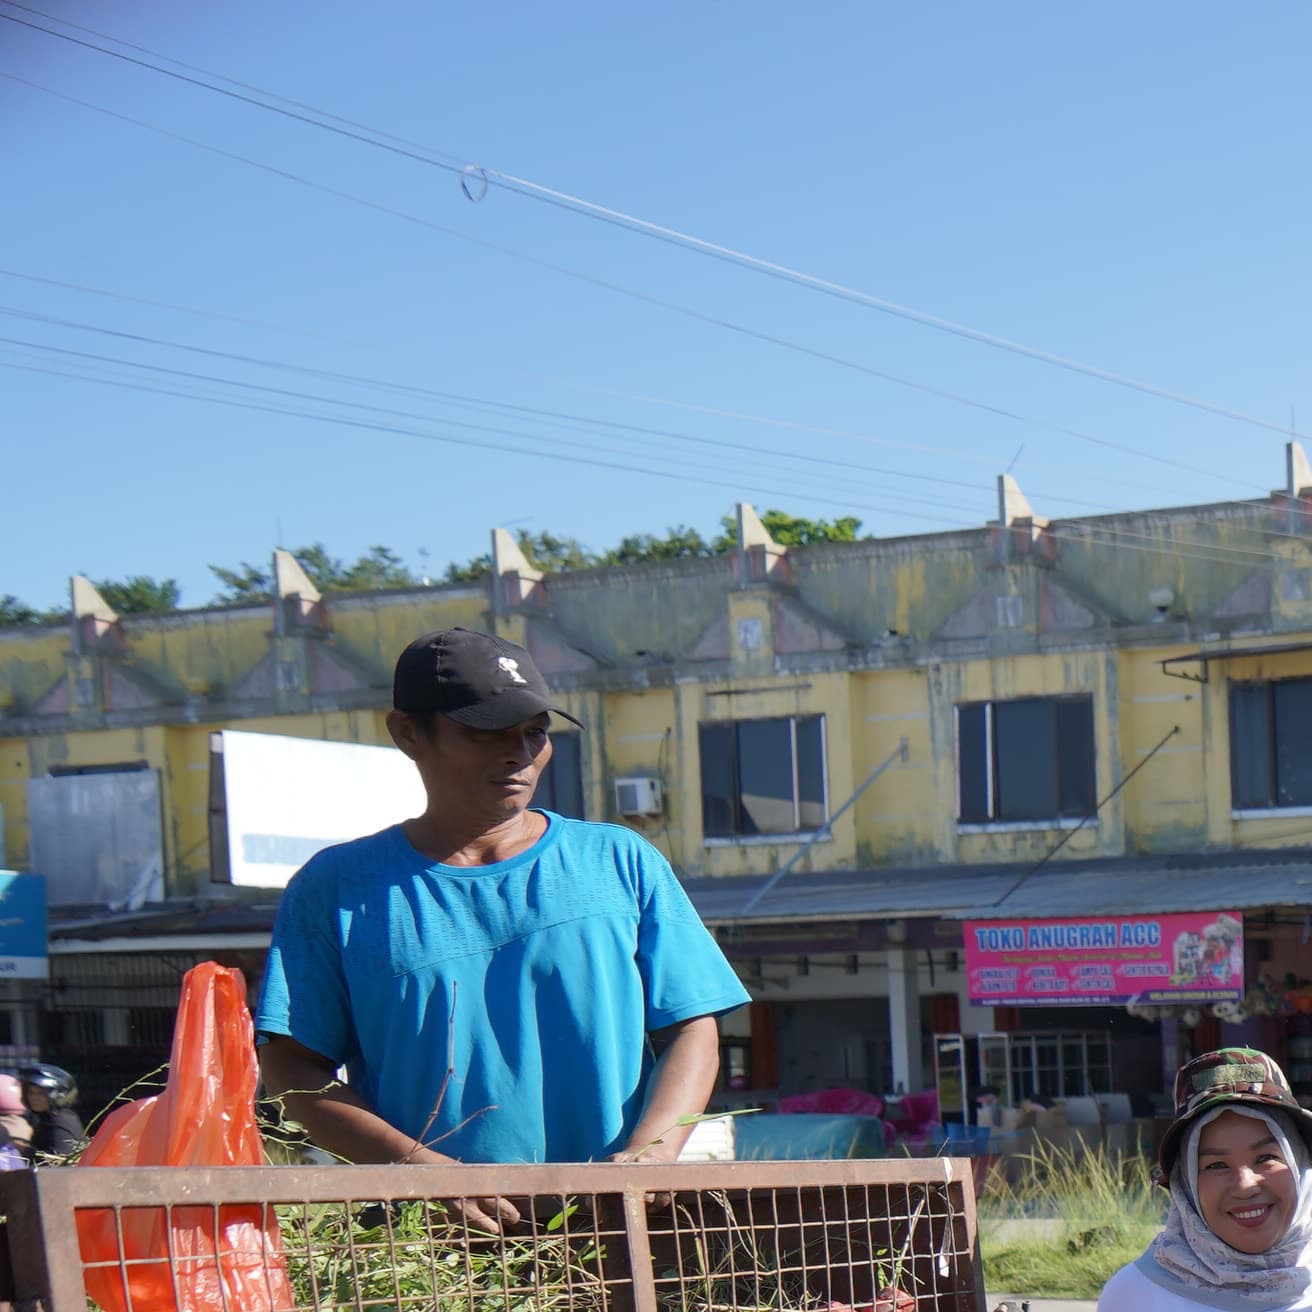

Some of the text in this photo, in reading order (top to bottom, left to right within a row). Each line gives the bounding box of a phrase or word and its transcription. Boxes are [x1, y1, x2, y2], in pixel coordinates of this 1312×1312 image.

[975, 919, 1161, 952] TOKO ANUGRAH ACC
